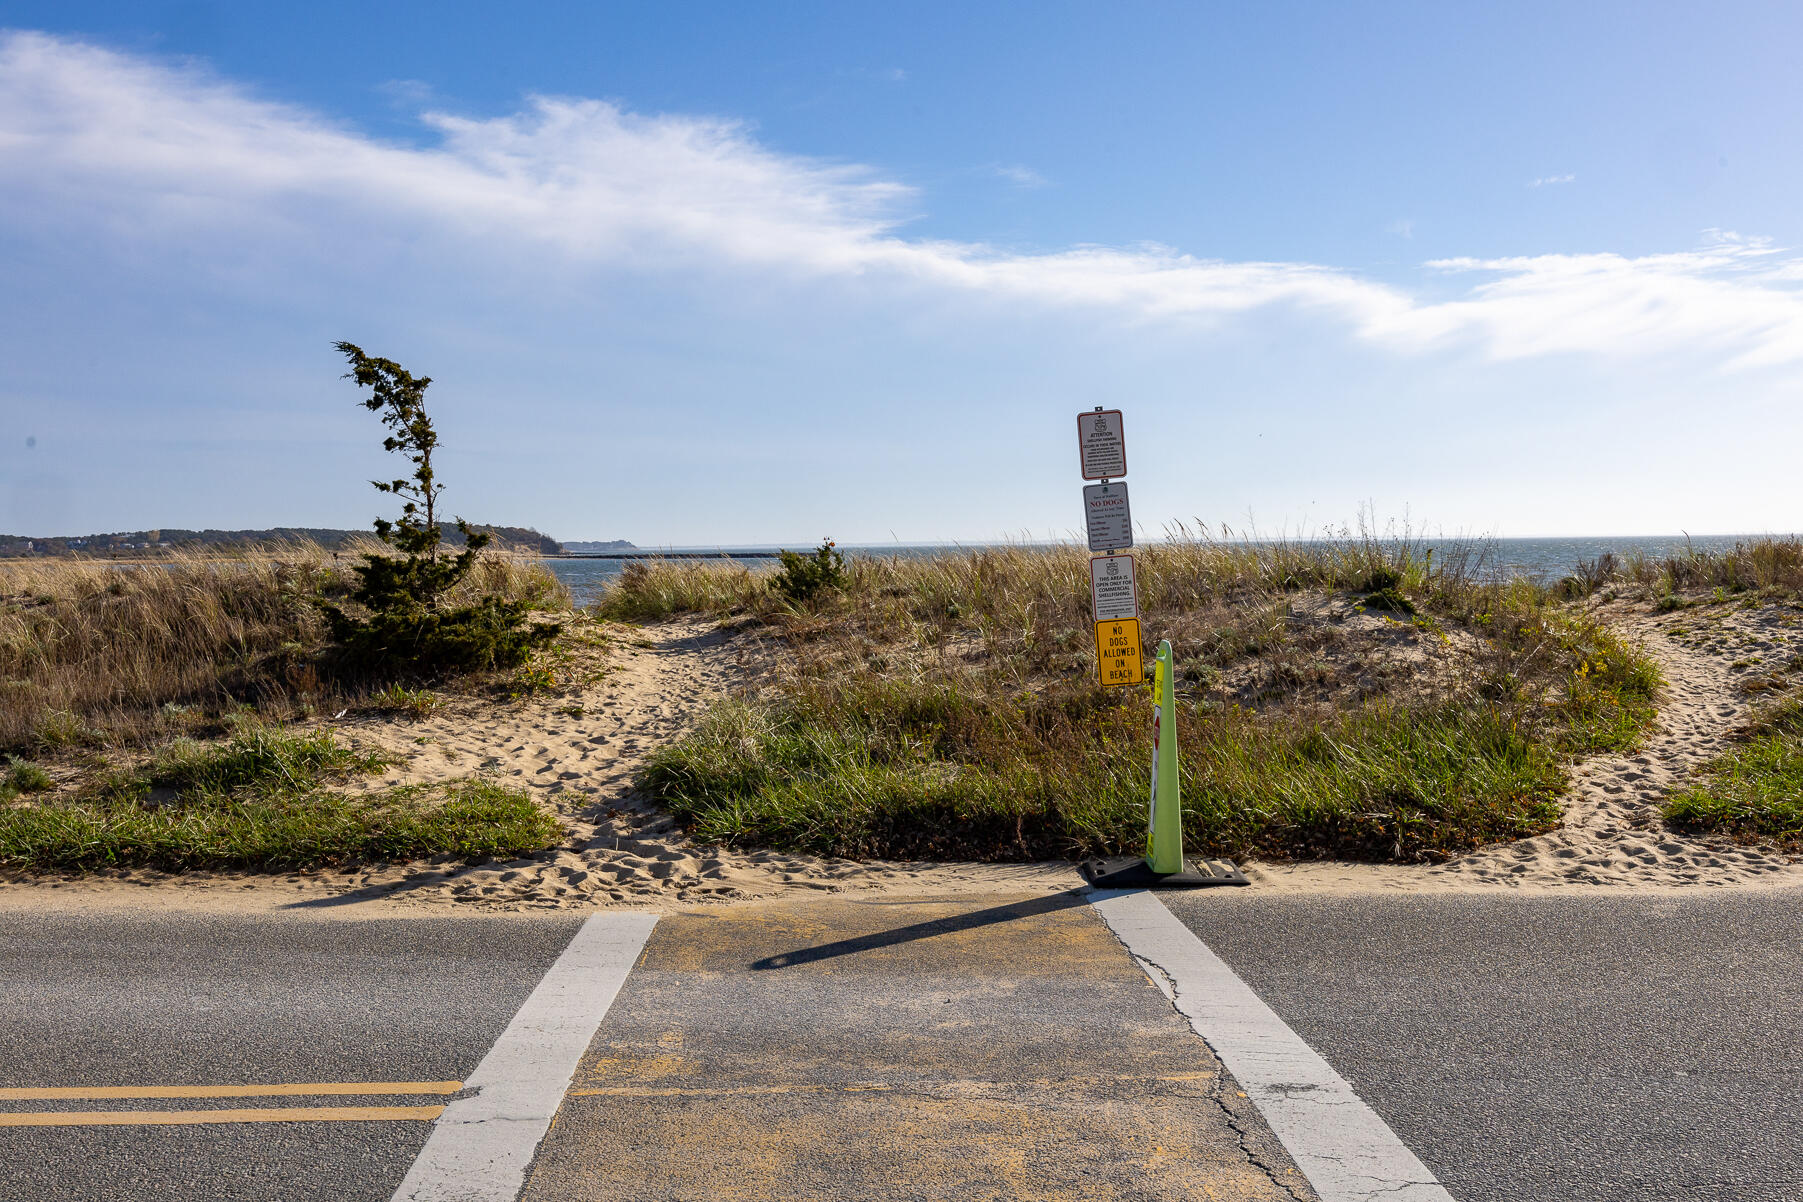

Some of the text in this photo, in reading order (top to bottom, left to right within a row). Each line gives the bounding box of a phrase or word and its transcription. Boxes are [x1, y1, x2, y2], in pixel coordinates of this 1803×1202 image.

[1103, 498, 1123, 506] DOGS
[1113, 626, 1122, 635] NO
[1110, 637, 1128, 646] DOGS
[1104, 647, 1135, 658] ALLOWED
[1116, 659, 1125, 668] ON
[1110, 669, 1133, 679] BEACH
